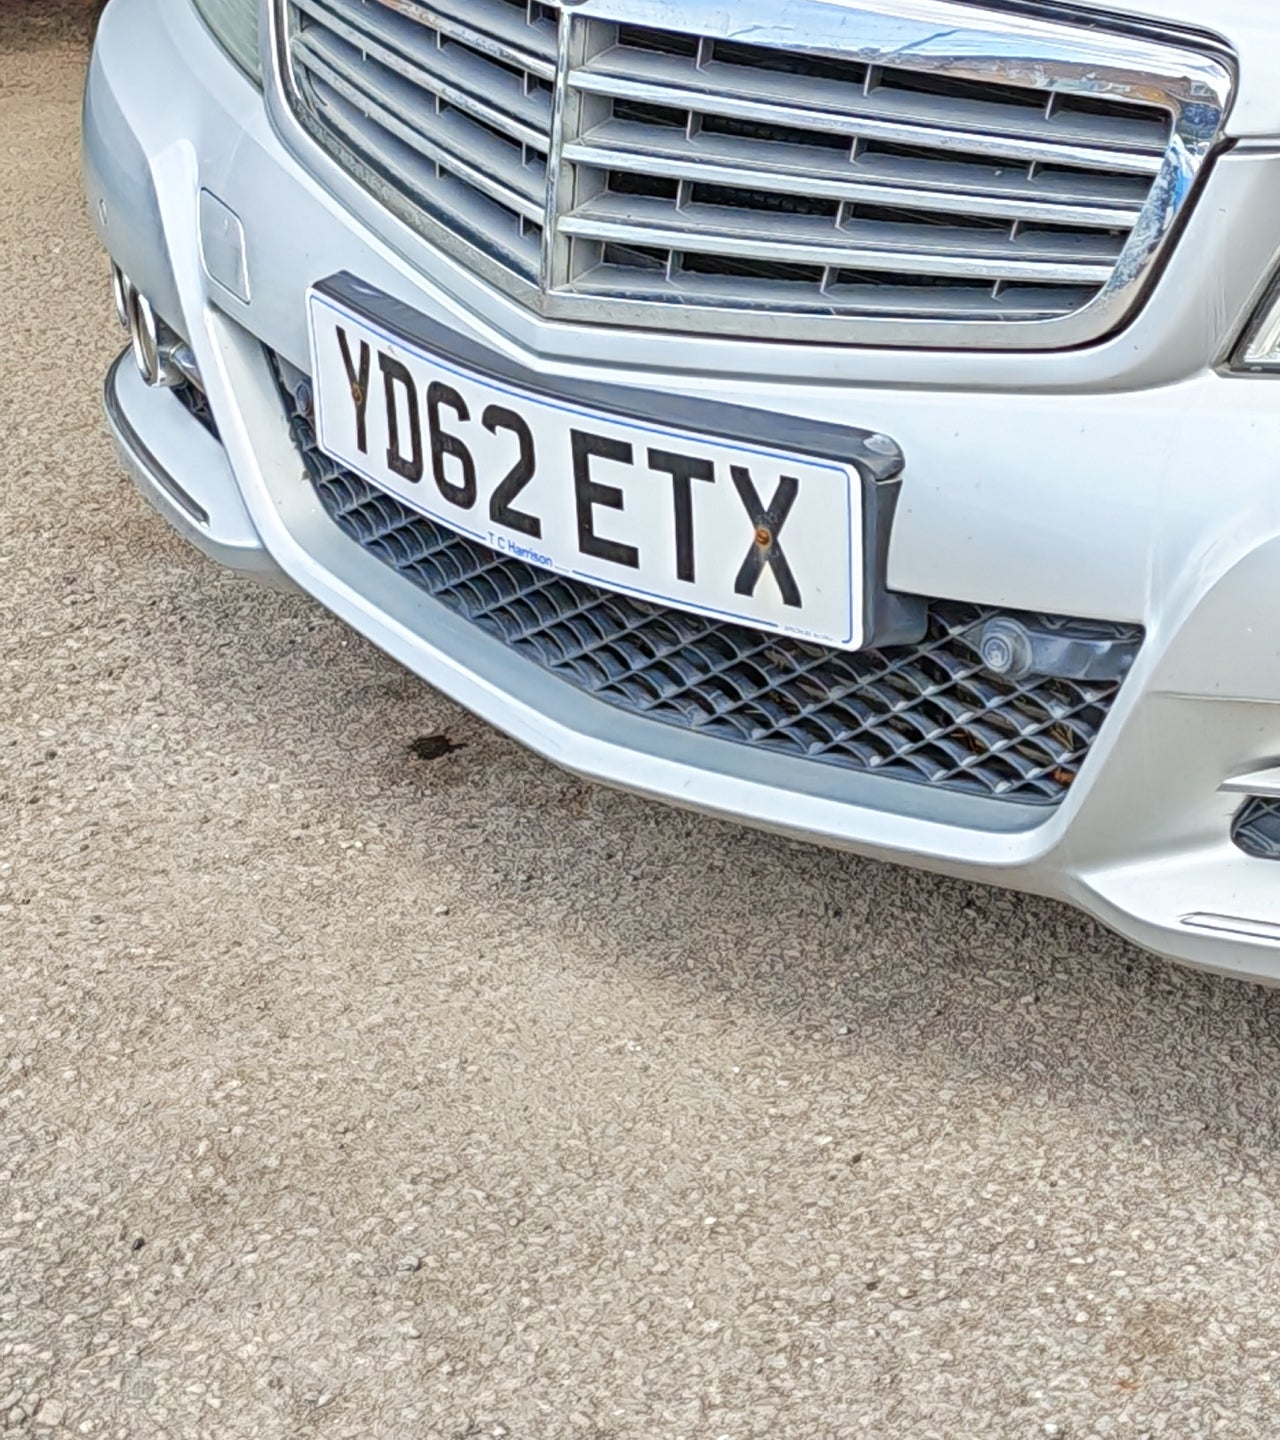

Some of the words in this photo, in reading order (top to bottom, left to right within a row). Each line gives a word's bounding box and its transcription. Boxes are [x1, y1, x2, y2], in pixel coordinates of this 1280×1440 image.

[335, 324, 541, 540] YD62
[570, 427, 803, 610] ETX
[487, 531, 495, 545] T
[497, 536, 506, 550] C
[508, 539, 554, 568] Harrison
